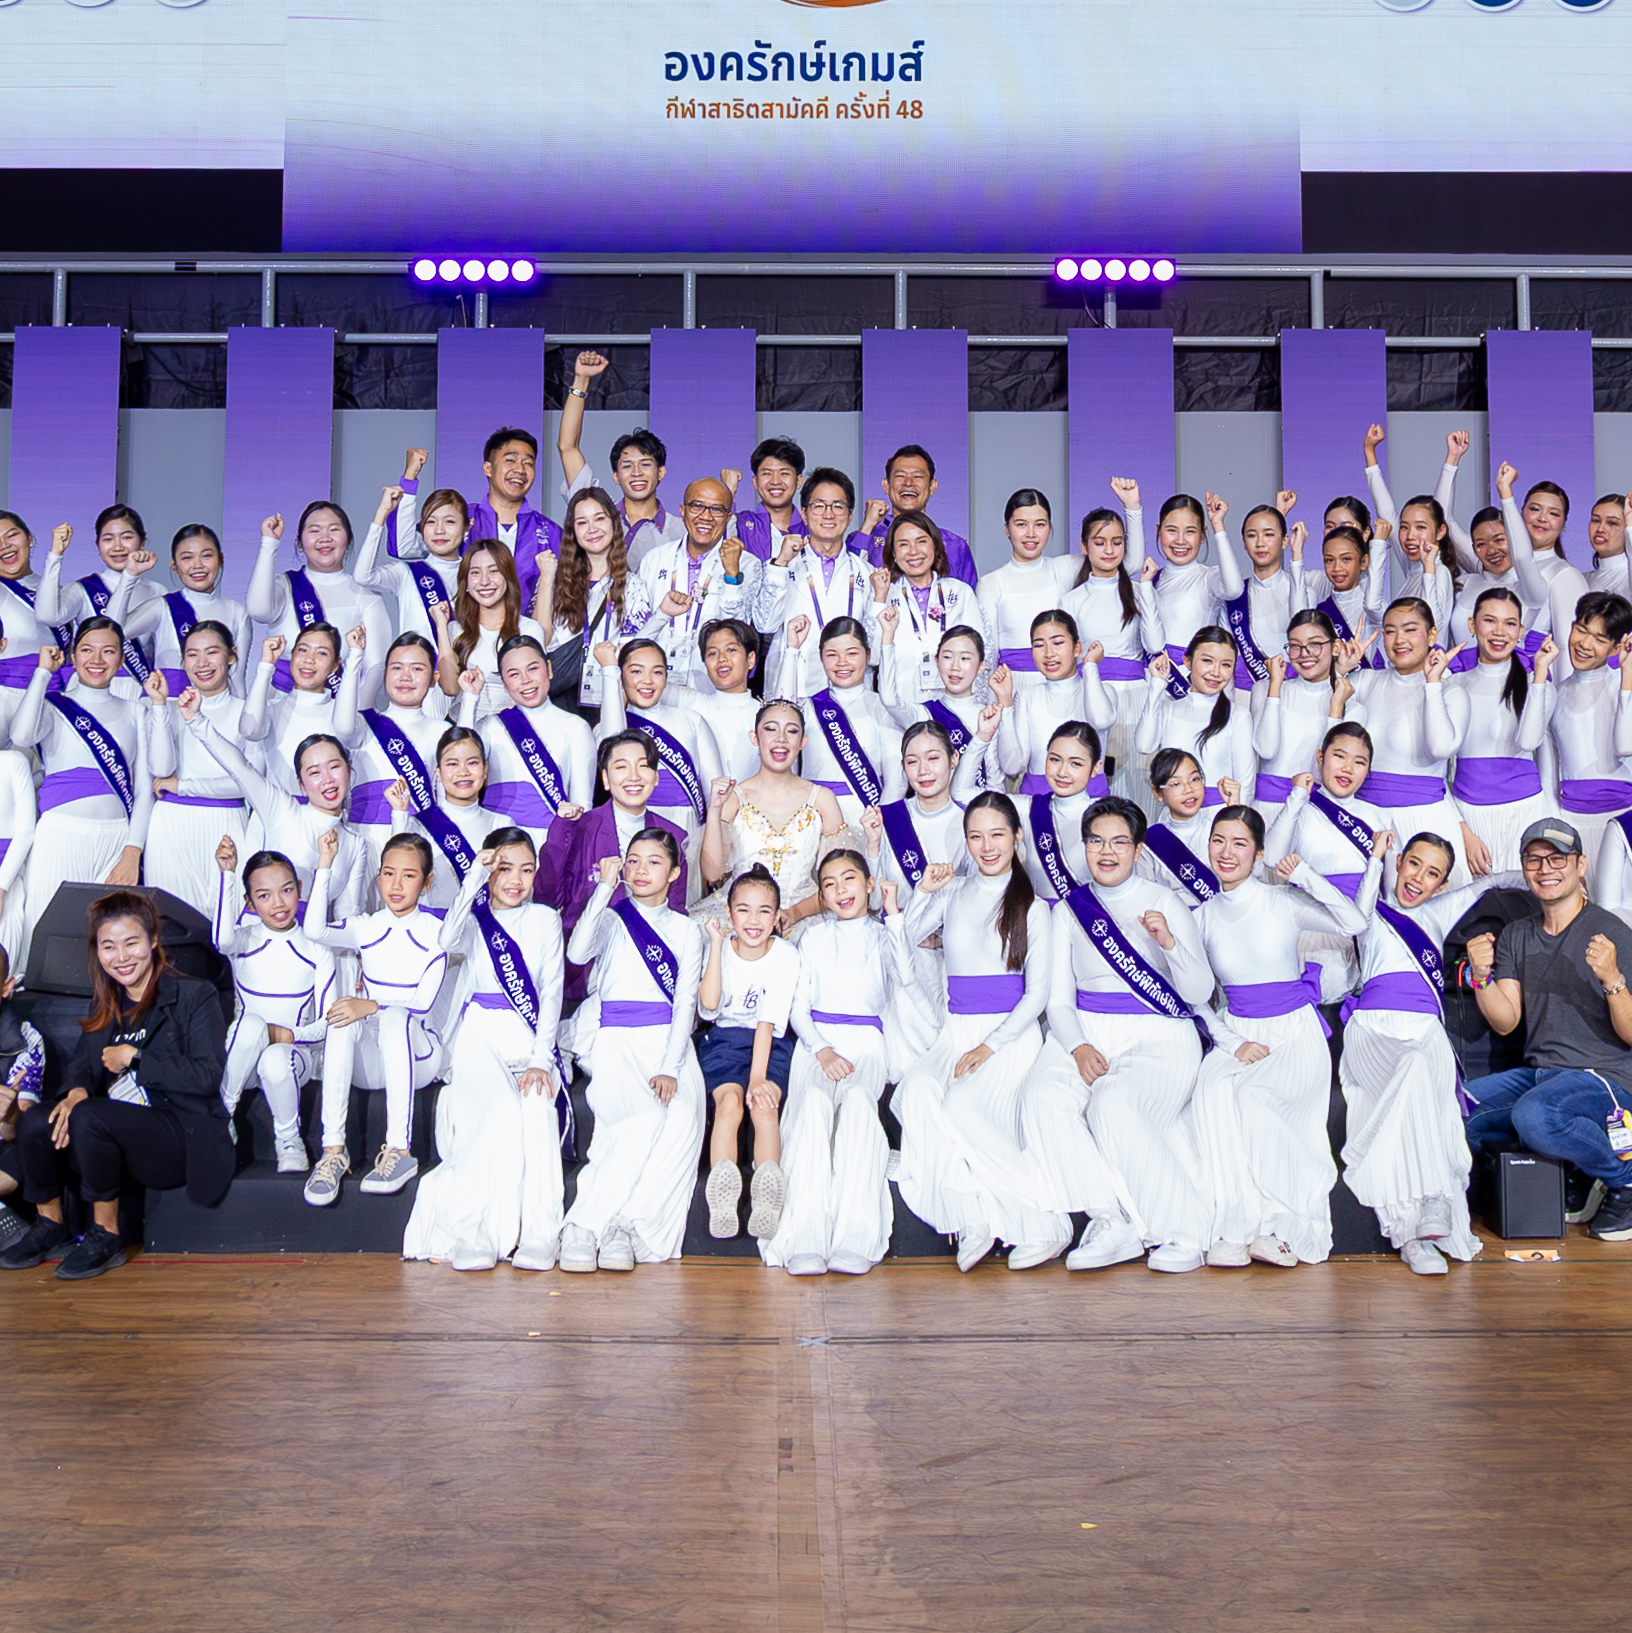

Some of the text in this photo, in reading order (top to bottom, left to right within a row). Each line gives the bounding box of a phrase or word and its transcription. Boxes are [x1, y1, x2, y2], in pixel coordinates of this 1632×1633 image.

[664, 39, 925, 82] องครักษ์เกมส์
[665, 89, 924, 119] กีฬาสาธิตสามัคคี ครั้งที่ 48
[1102, 935, 1180, 1018] องครักษ์พิทักษ์ฝัน
